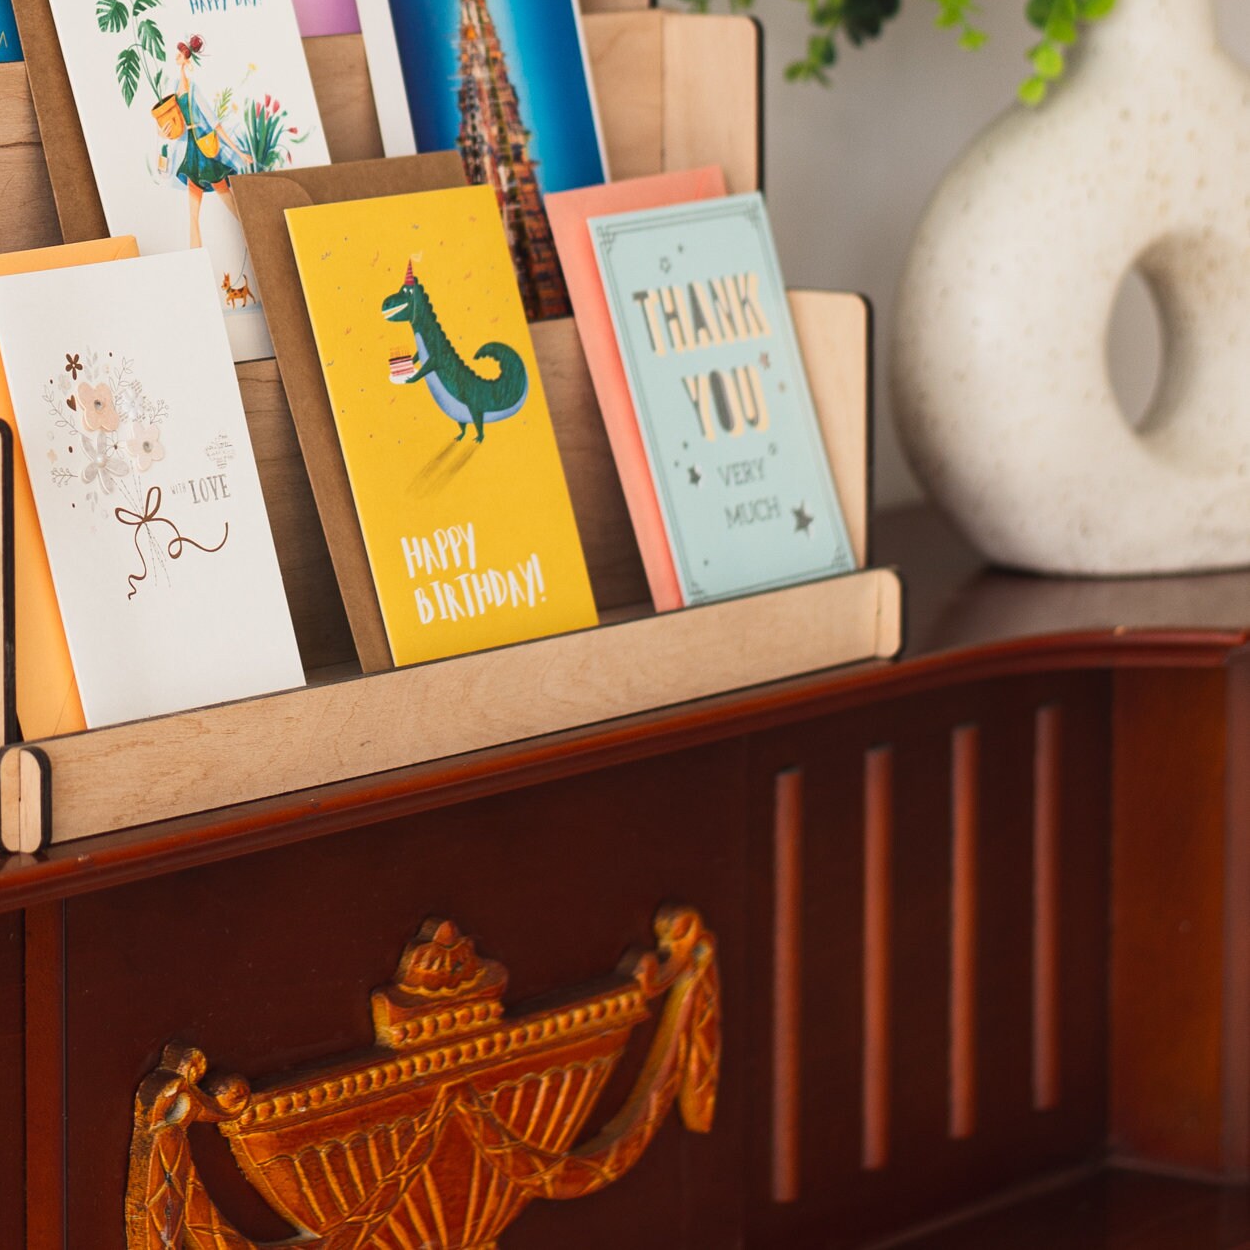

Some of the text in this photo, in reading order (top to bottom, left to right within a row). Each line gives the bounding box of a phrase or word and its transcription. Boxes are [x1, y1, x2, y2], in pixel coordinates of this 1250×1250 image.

[632, 271, 772, 357] THANK
[681, 364, 770, 442] YOU
[188, 473, 232, 505] LOVE
[716, 457, 766, 487] VERY
[724, 496, 781, 529] MUCH
[400, 522, 476, 579] HAPPY
[413, 553, 547, 625] BIRTHDAY!
